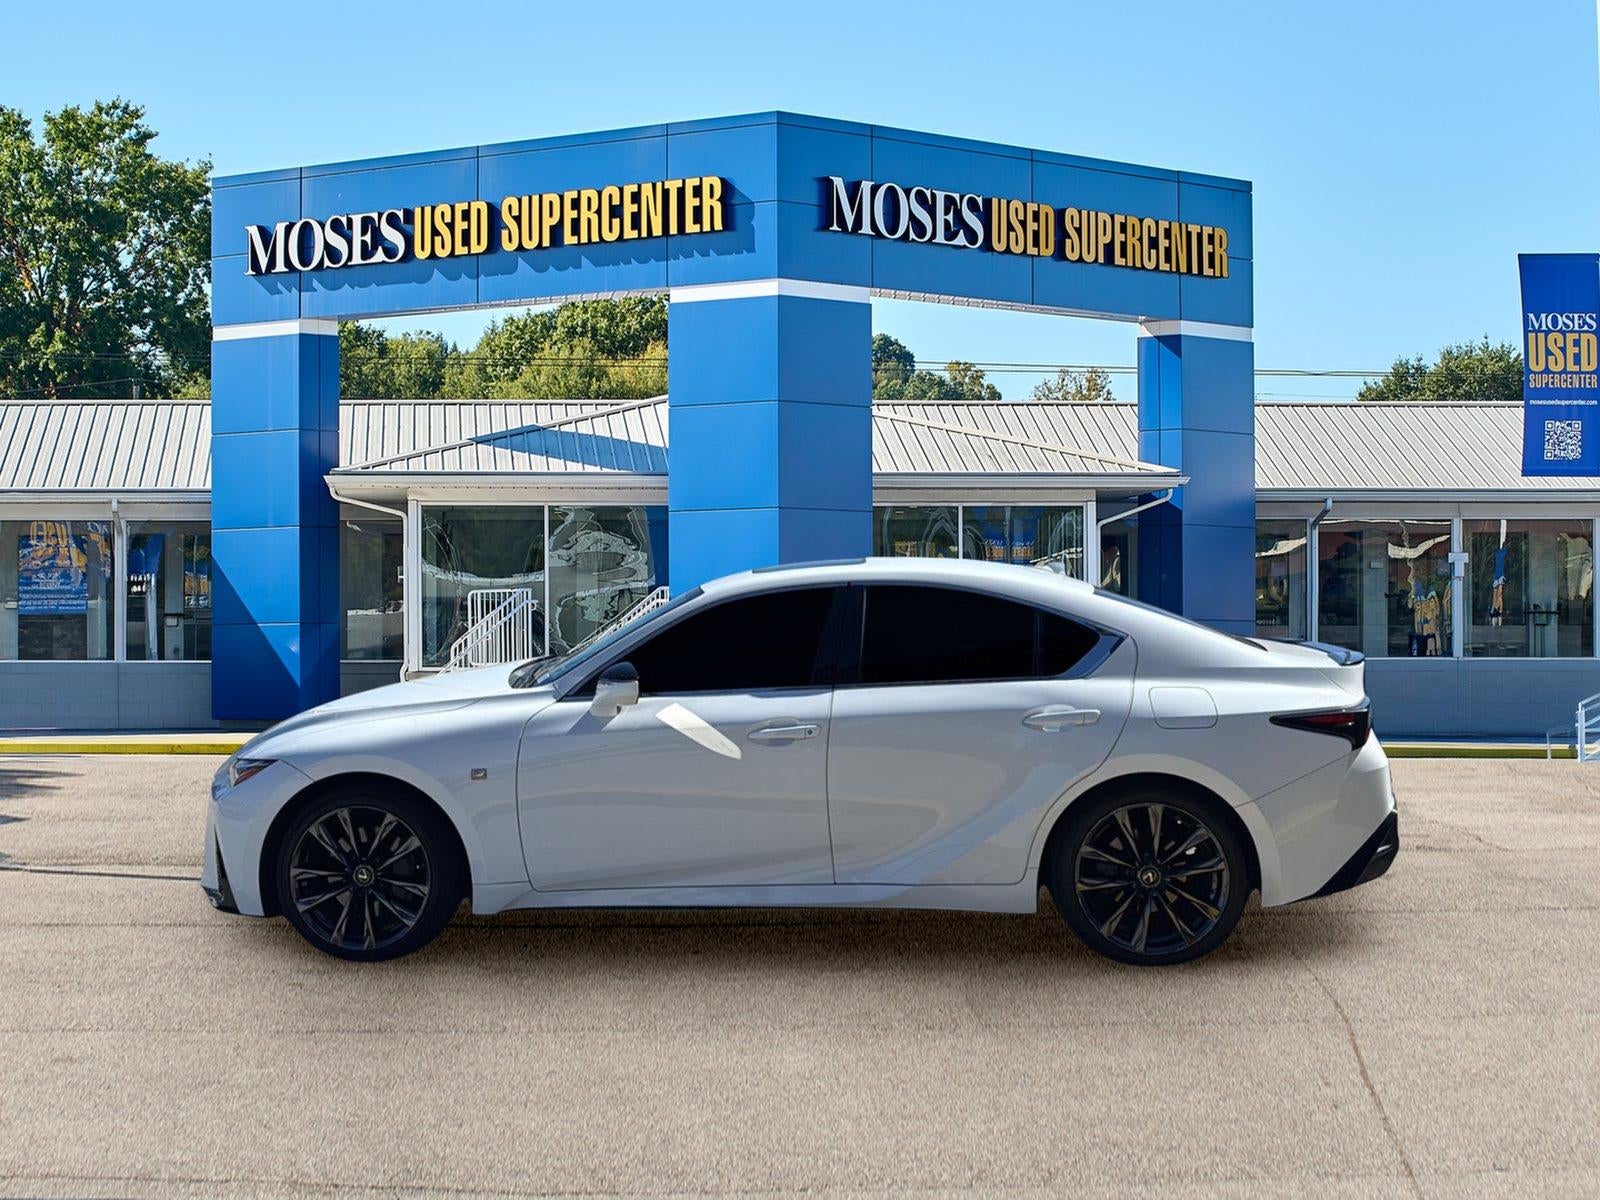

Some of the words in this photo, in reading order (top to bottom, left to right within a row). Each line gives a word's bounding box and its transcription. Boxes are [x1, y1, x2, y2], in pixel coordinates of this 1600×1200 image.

[245, 208, 405, 276] MOSES
[413, 200, 489, 260] USED
[501, 175, 724, 252] SUPERCENTER
[828, 176, 984, 249] MOSES
[991, 197, 1055, 257] USED
[1065, 207, 1229, 278] SUPERCENTER
[1528, 313, 1597, 331] MOSES
[1528, 333, 1598, 372] USED
[1529, 374, 1598, 388] SUPERCENTER
